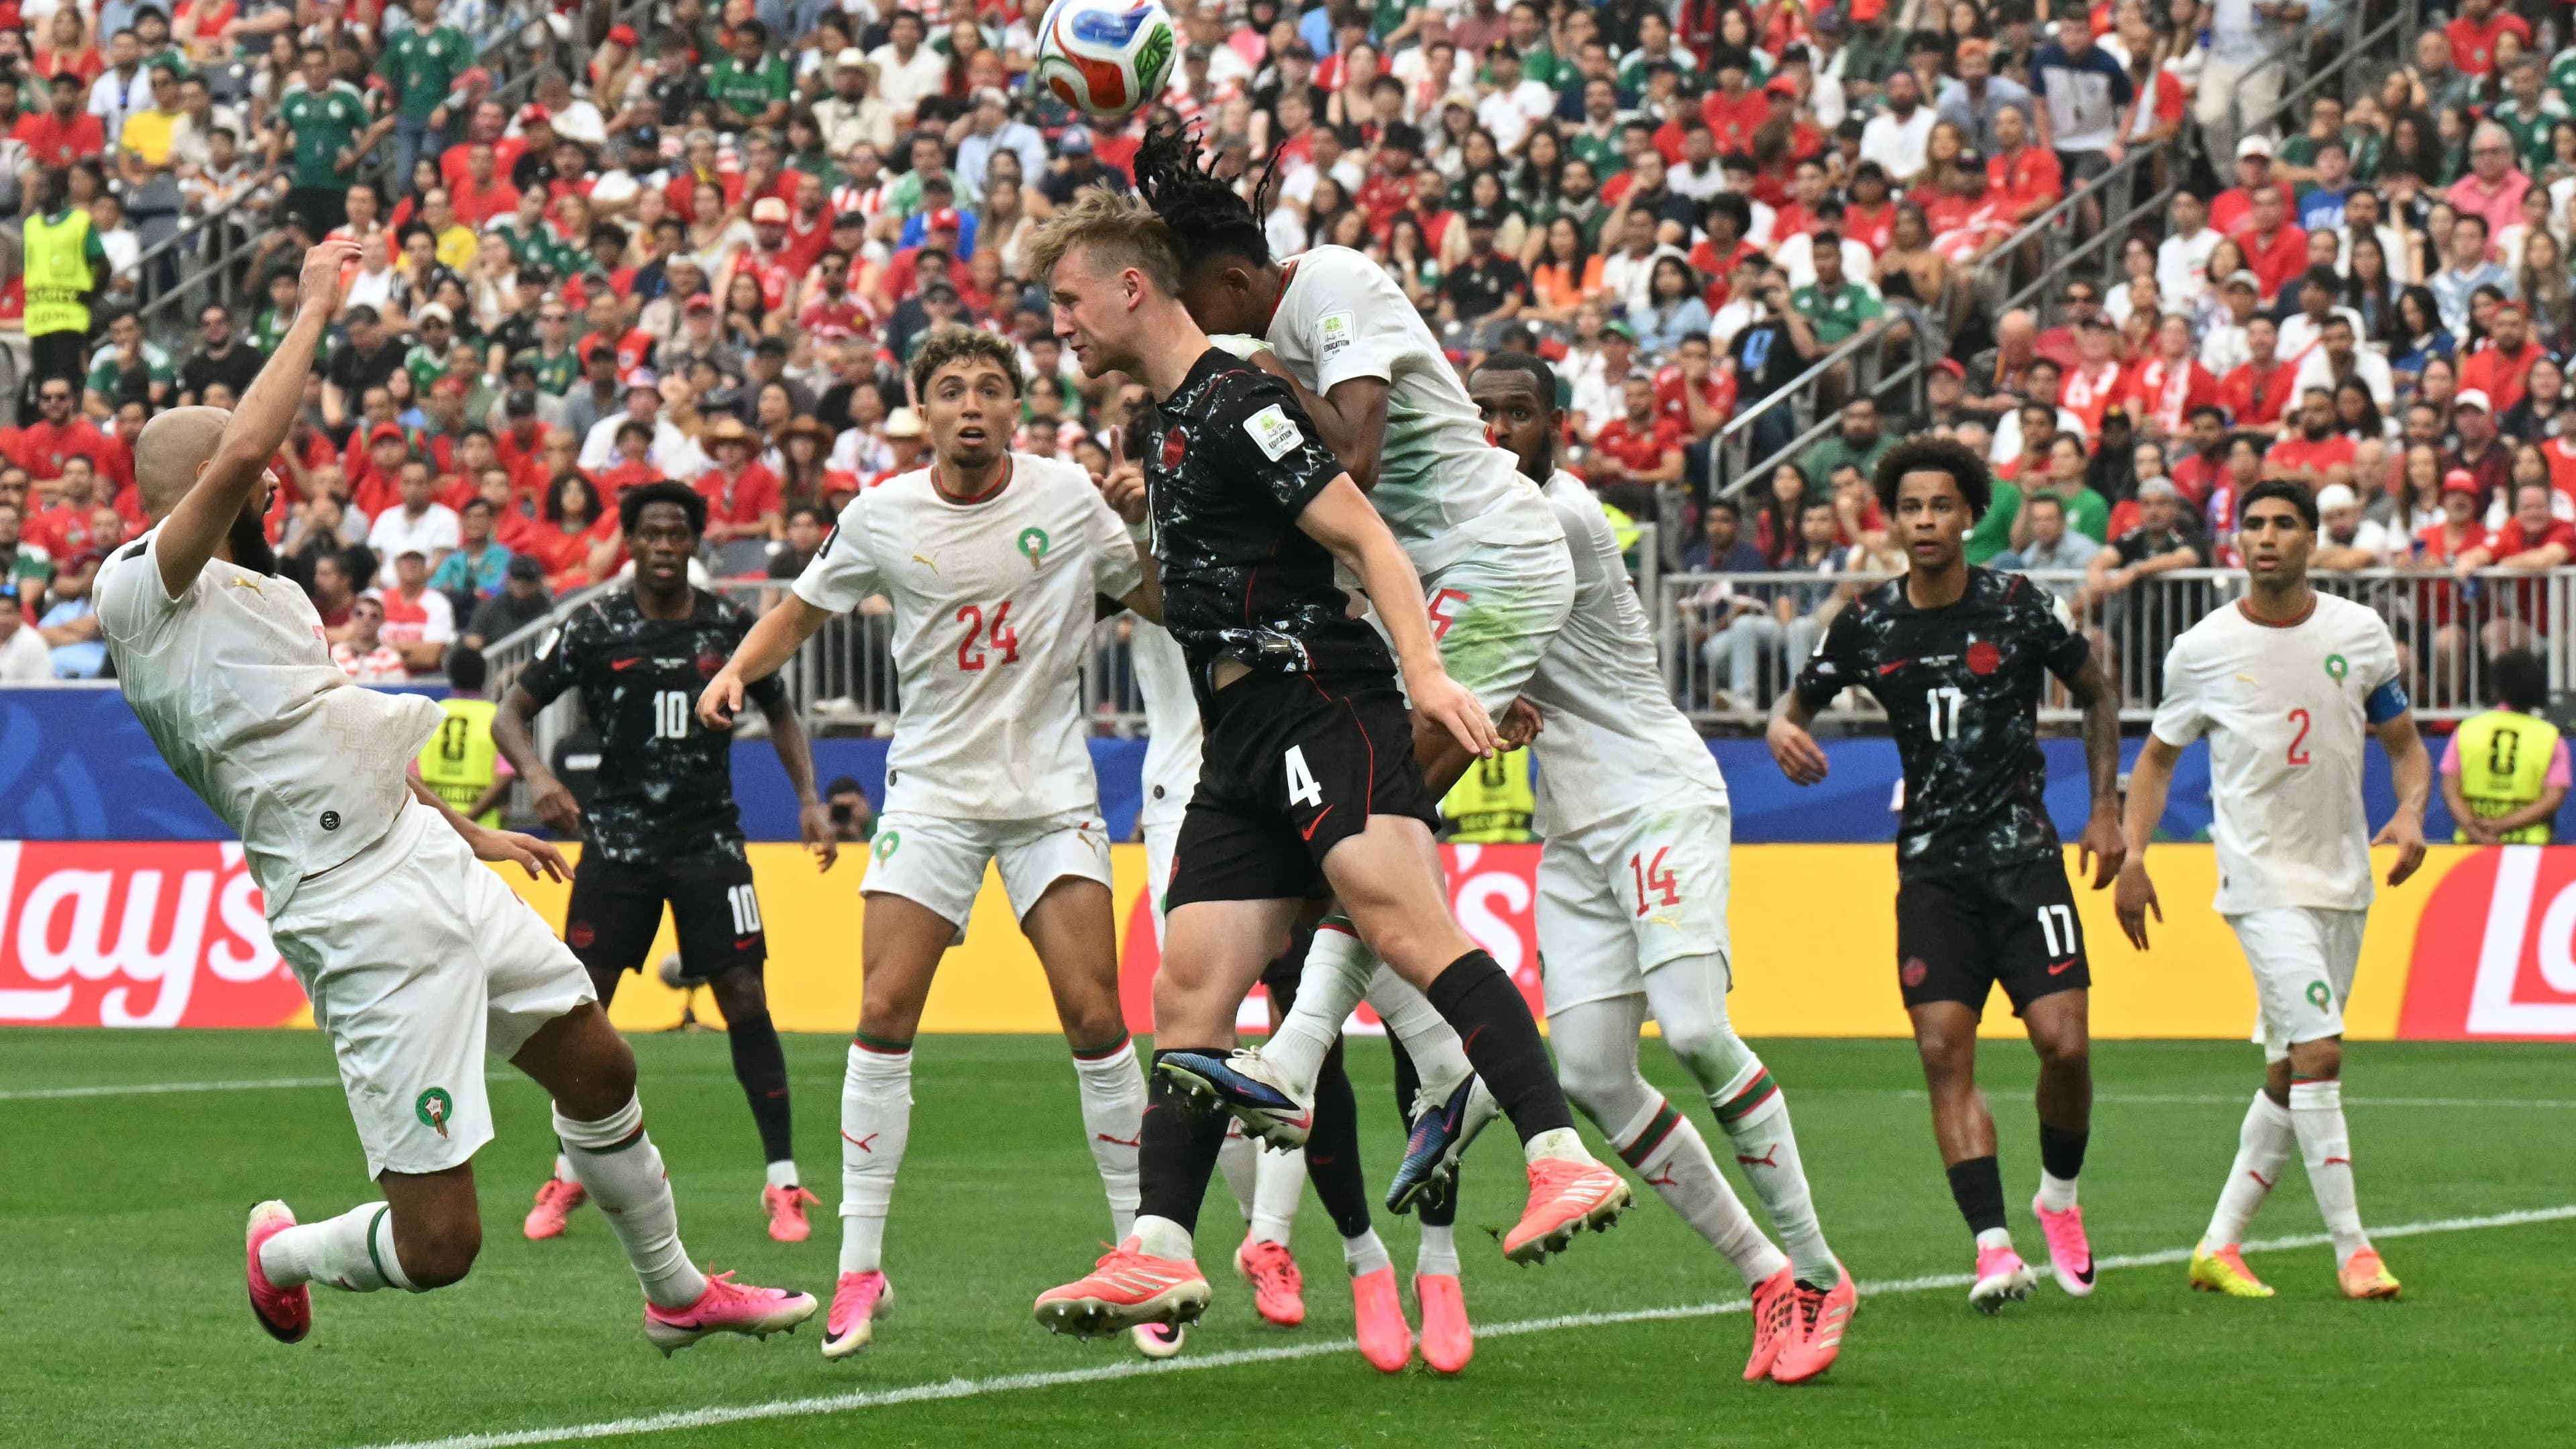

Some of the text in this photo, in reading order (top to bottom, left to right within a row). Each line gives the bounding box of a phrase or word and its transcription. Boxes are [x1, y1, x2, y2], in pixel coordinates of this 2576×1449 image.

[1324, 339, 1350, 352] EDUCATION
[1268, 429, 1293, 449] EDUCATION
[957, 600, 1019, 670] 24
[653, 690, 688, 739] 10
[1927, 687, 1963, 742] 17
[2288, 708, 2310, 765] 2
[1285, 744, 1322, 808] 4
[727, 884, 761, 934] 10
[1630, 847, 1680, 917] 14
[2037, 904, 2076, 957] 17
